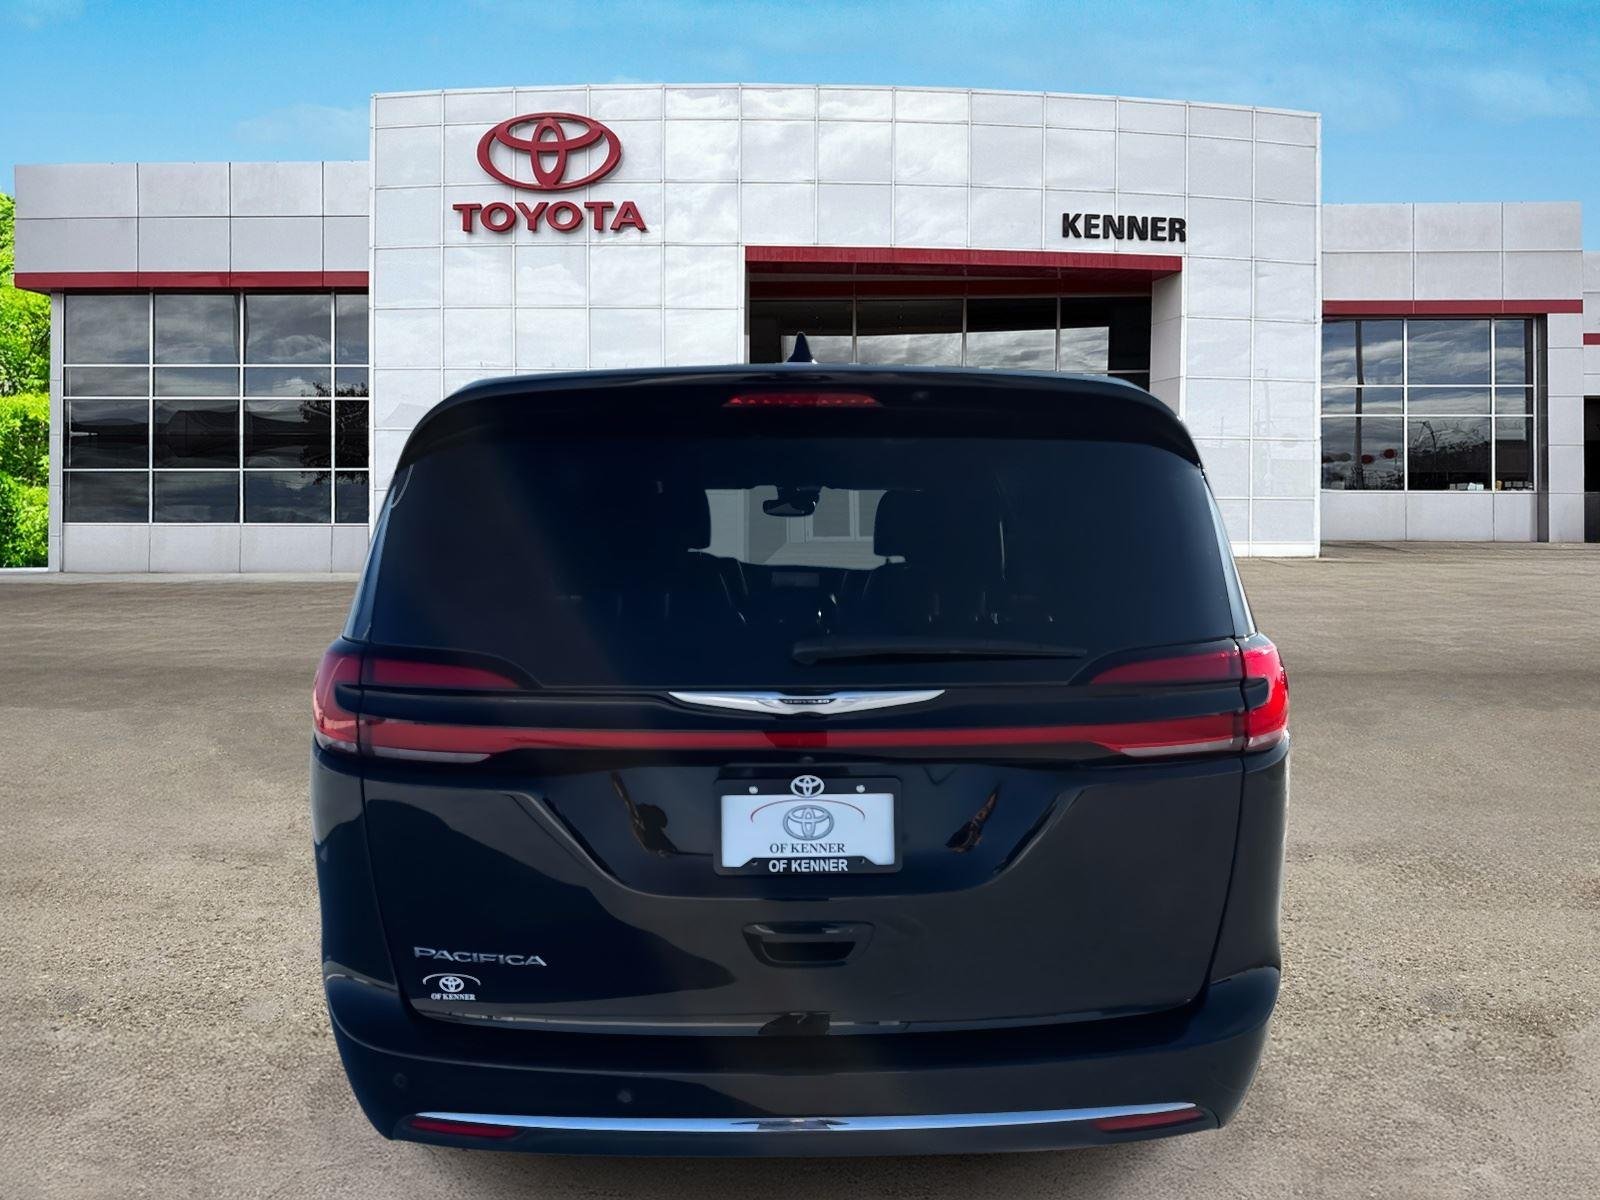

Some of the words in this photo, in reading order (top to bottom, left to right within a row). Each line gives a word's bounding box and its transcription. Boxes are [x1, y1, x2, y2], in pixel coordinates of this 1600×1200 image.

[452, 201, 647, 232] TOYOTA
[1062, 213, 1187, 242] KENNER
[769, 843, 788, 854] OF
[791, 843, 846, 853] KENNER
[768, 859, 788, 872] OF
[791, 859, 848, 872] KENNER
[414, 946, 547, 967] PACIFICA
[430, 992, 442, 1001] OF
[442, 993, 476, 1001] KENNER
